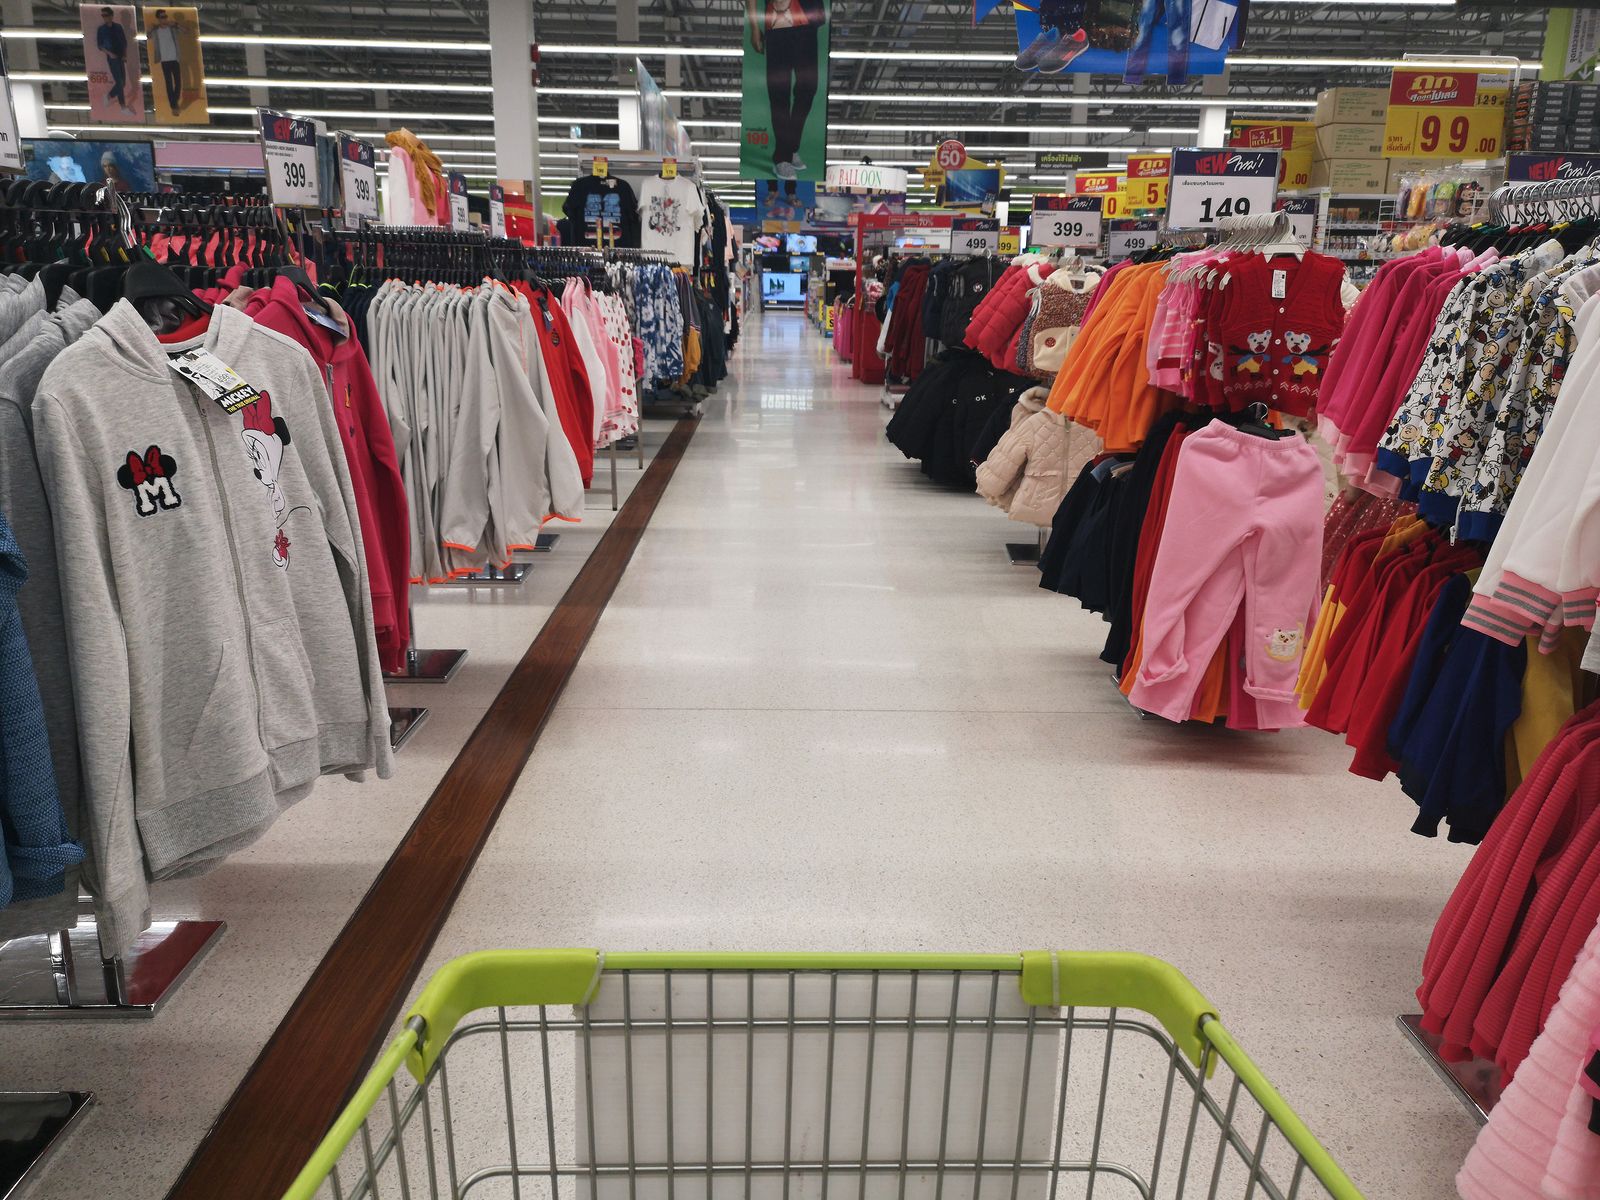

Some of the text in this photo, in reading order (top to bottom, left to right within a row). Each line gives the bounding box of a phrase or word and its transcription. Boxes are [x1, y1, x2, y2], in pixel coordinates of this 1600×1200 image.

[746, 132, 769, 145] 199
[940, 151, 960, 166] 50
[1195, 152, 1233, 175] NEW
[1529, 155, 1566, 180] NEW
[284, 162, 306, 187] 399
[839, 169, 881, 187] BALLOON
[354, 178, 370, 200] 399
[1199, 197, 1251, 223] 149
[1053, 222, 1083, 237] 399
[966, 238, 987, 249] 499
[1124, 238, 1145, 249] 499
[220, 386, 255, 408] MICKEY
[137, 476, 181, 515] M
